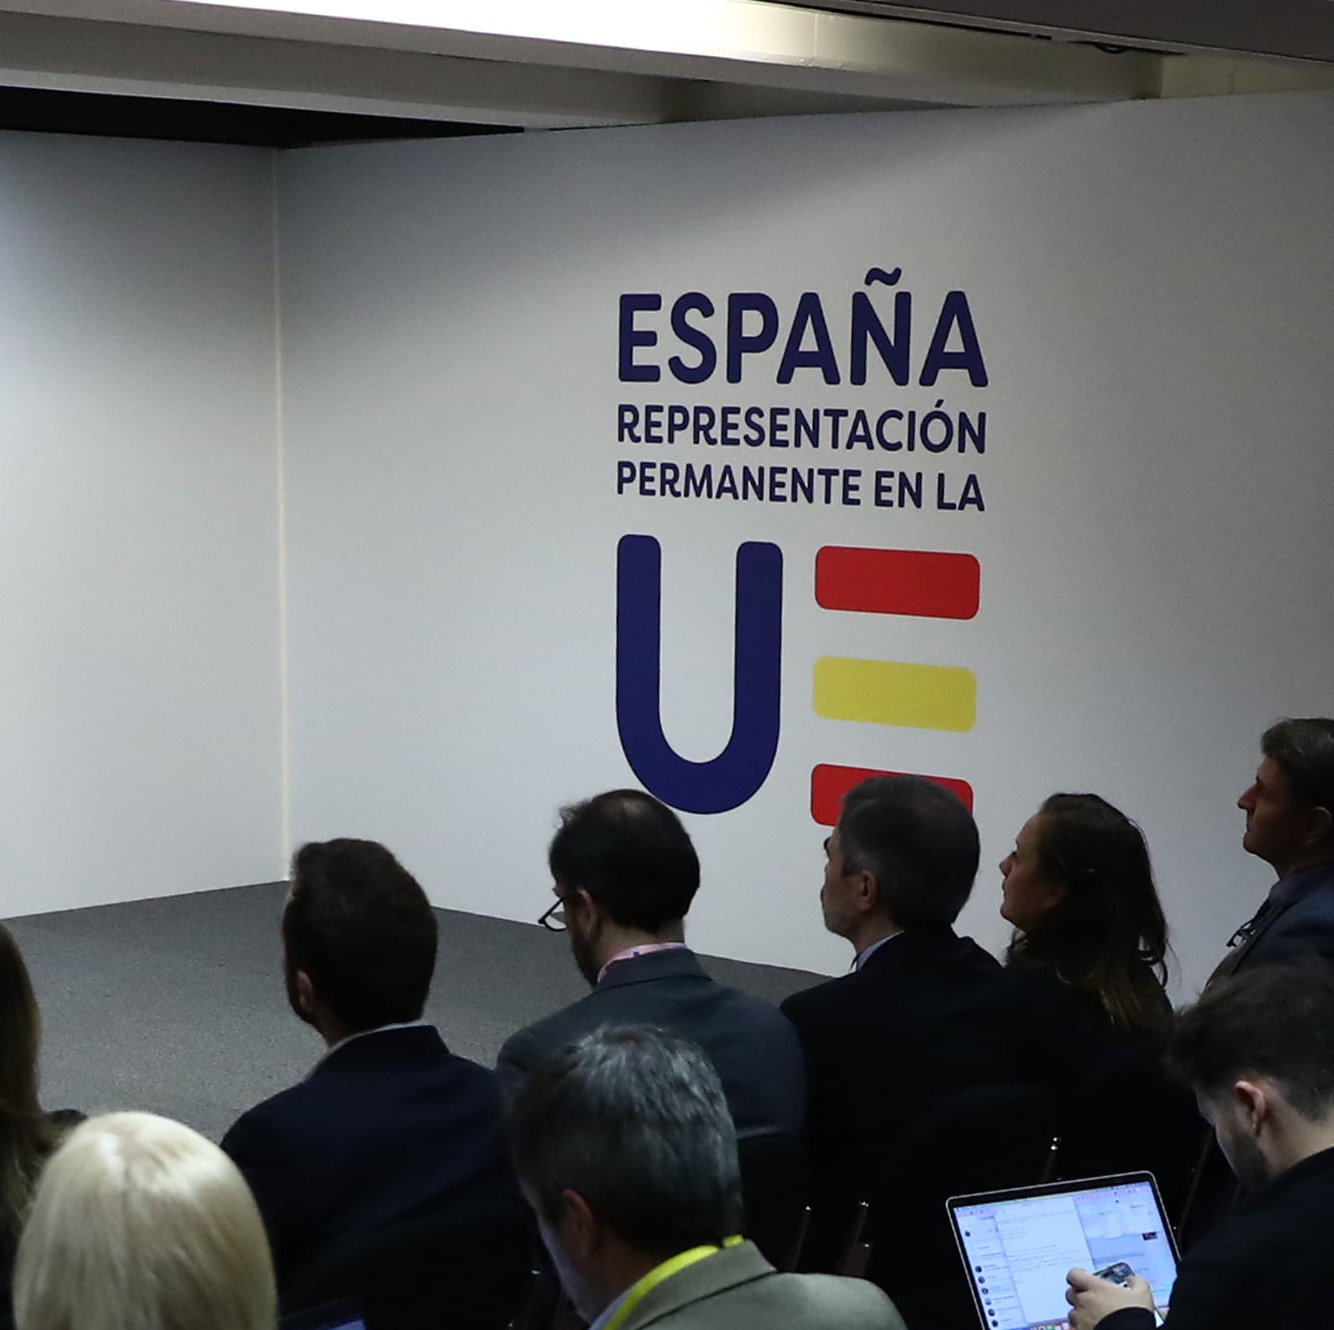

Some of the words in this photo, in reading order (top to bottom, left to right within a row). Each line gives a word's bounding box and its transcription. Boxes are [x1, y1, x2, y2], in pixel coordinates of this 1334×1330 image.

[618, 267, 989, 388] ESPAÑA
[617, 398, 987, 454] REPRESENTACIÓN
[617, 460, 862, 507] PERMANENTE
[874, 470, 923, 509] EN
[936, 473, 986, 512] LA
[616, 534, 981, 826] UE
